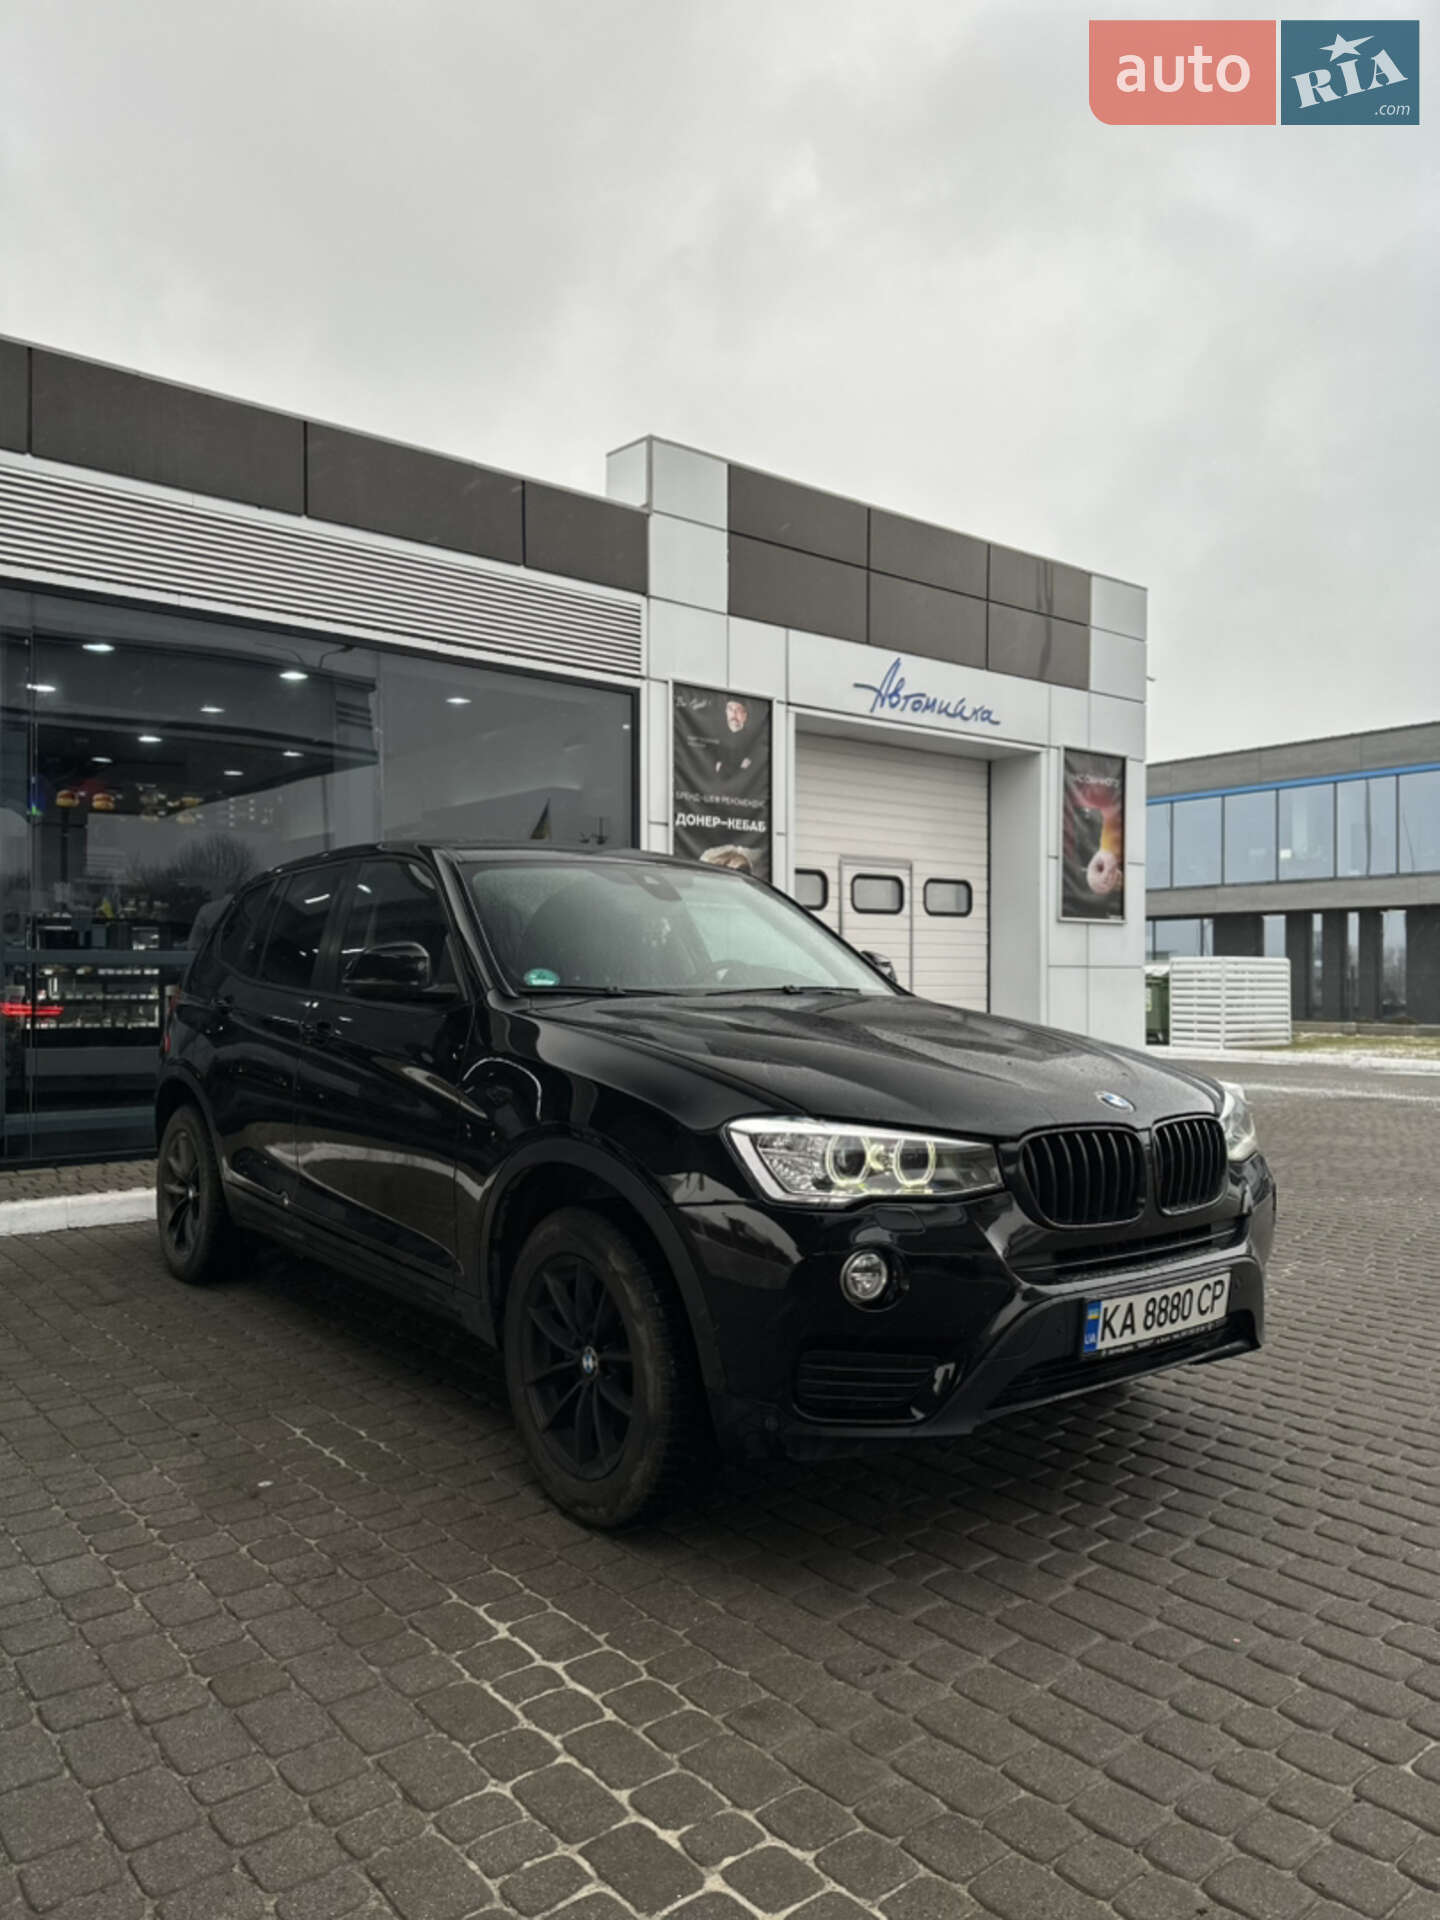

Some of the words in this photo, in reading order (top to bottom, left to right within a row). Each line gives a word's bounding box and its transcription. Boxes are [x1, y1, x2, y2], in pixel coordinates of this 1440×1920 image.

[853, 657, 1001, 725] Автомийка
[675, 812, 767, 833] ДОНЕР-КЕБАБ
[1100, 1302, 1136, 1342] KA
[1143, 1288, 1194, 1331] 8880
[1197, 1279, 1226, 1316] CP
